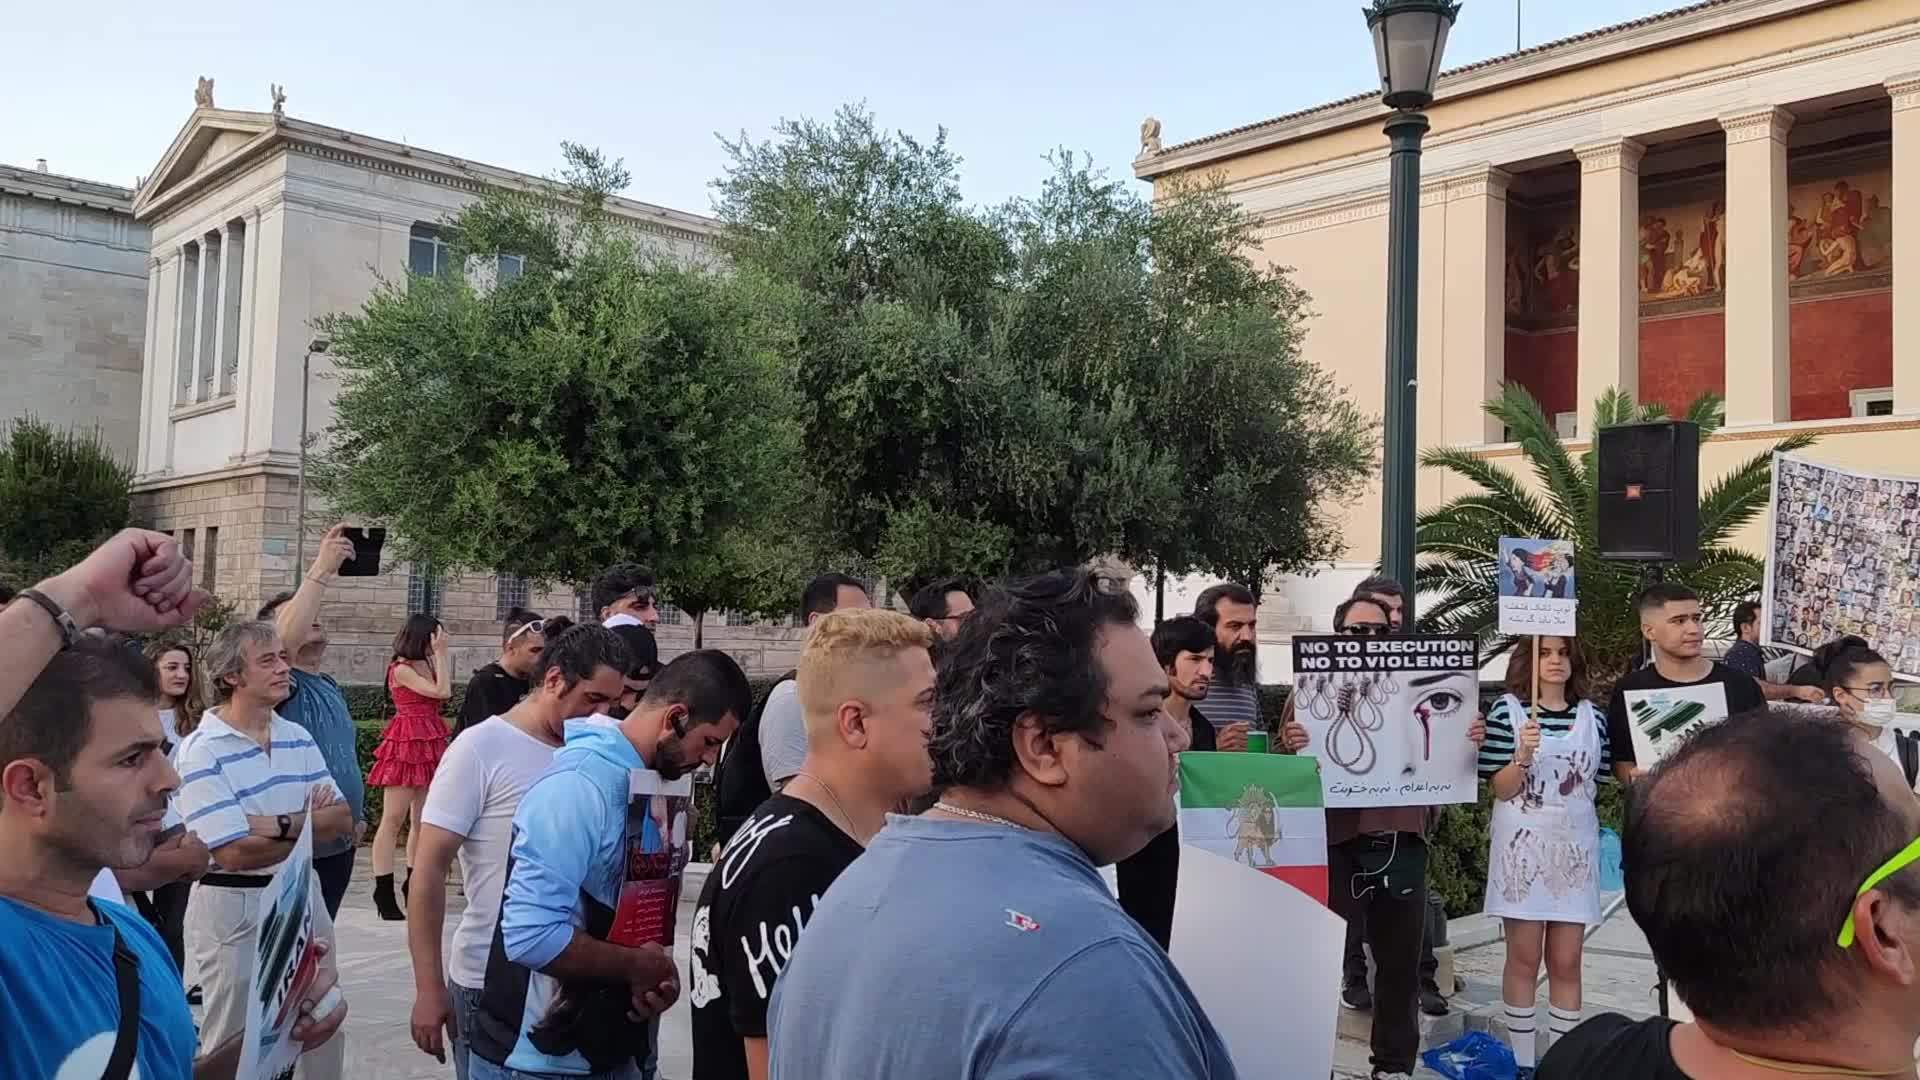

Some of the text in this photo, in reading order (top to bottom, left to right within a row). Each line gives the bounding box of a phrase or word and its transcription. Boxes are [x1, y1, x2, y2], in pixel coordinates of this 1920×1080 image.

[1300, 640, 1474, 653] NO TO EXECUTION
[1302, 655, 1473, 669] NO TO VIOLENCE
[1329, 781, 1367, 796] خشونت
[1400, 781, 1428, 796] اعدام
[741, 893, 820, 998] Hel
[278, 902, 312, 1009] IRAN
